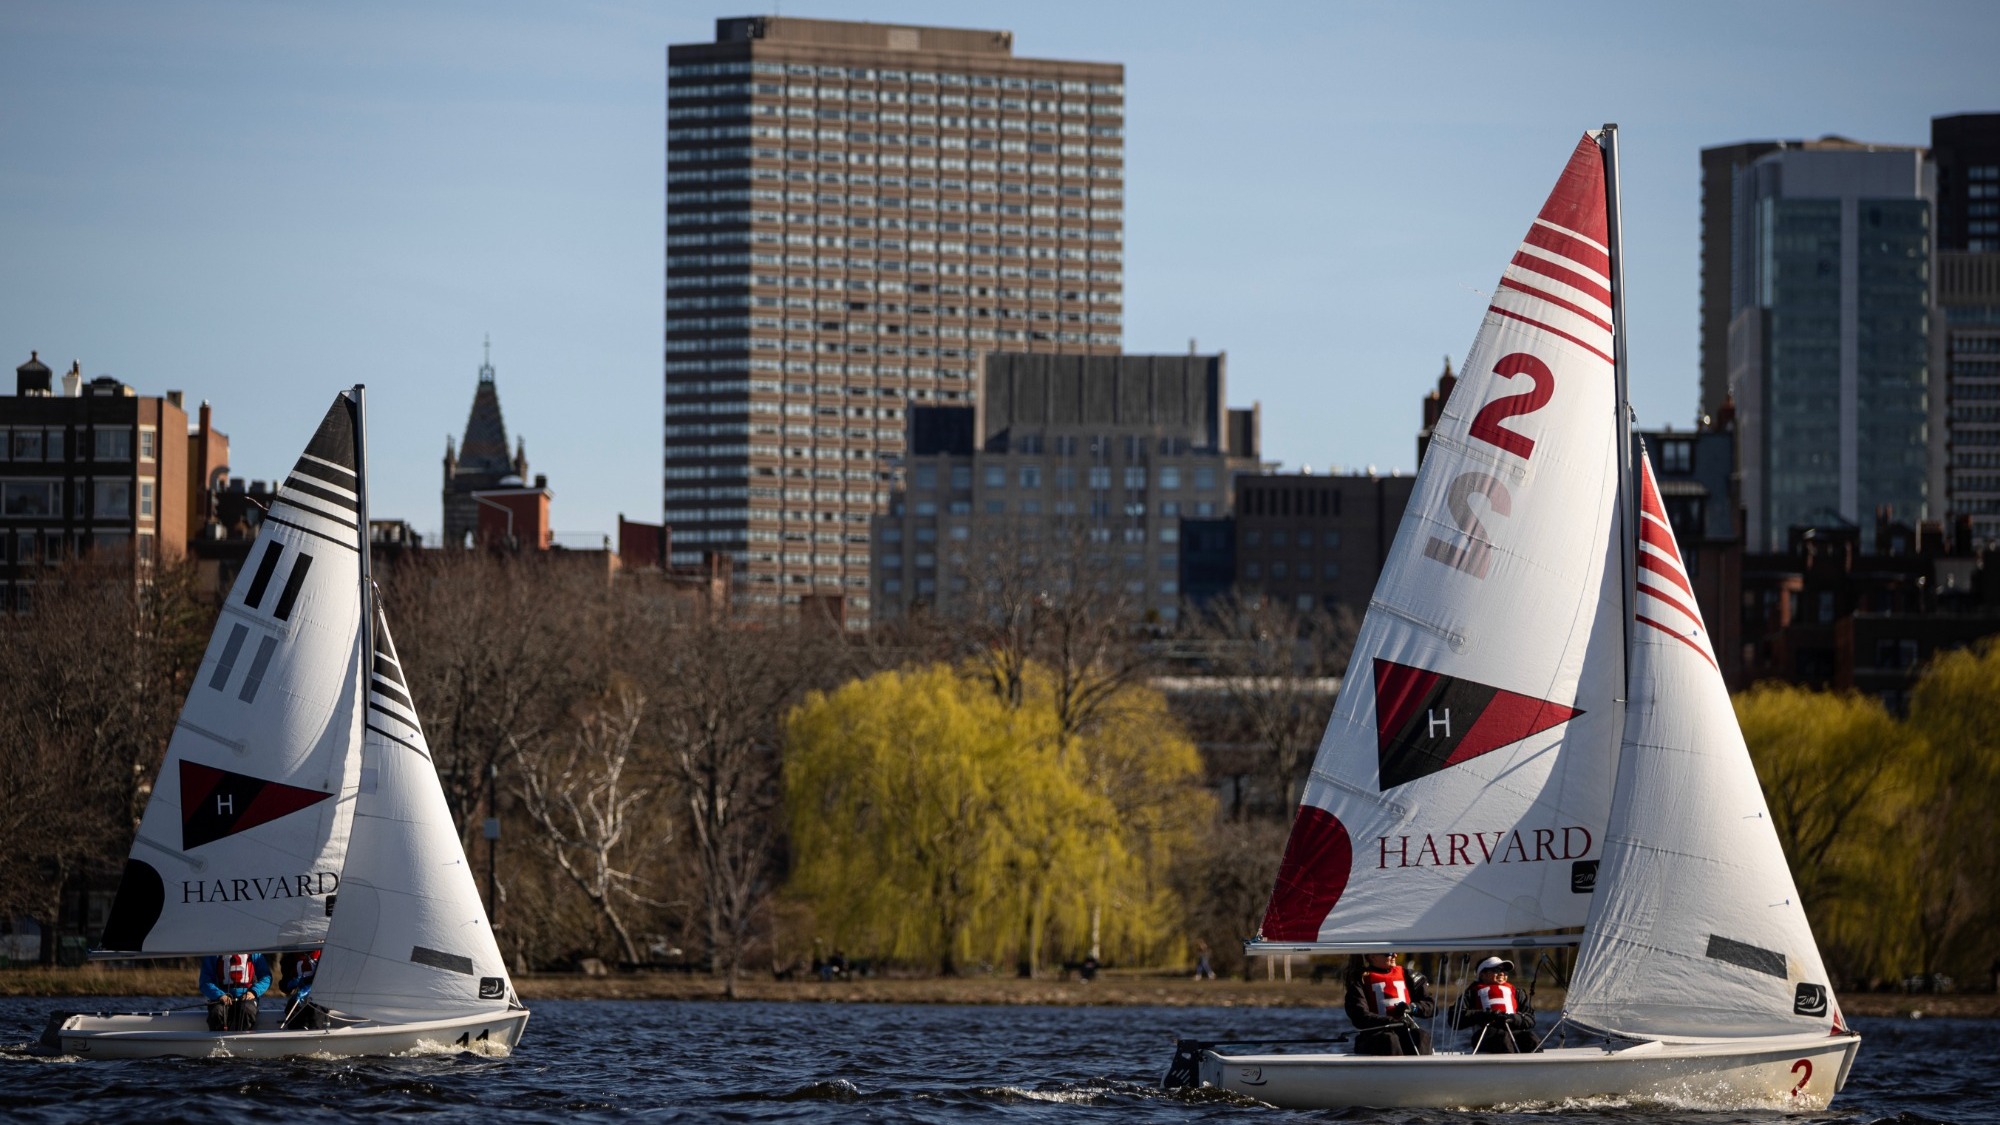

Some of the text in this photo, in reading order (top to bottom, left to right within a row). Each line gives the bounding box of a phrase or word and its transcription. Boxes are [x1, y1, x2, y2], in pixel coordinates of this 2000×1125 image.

[1469, 352, 1555, 460] 2
[243, 539, 314, 622] 11
[1428, 708, 1451, 738] H
[217, 794, 233, 815] H
[1376, 826, 1592, 869] HARVARD
[181, 872, 340, 904] HARVARD
[1371, 980, 1407, 1016] H
[1477, 984, 1516, 1015] H
[1791, 1058, 1813, 1097] 2
